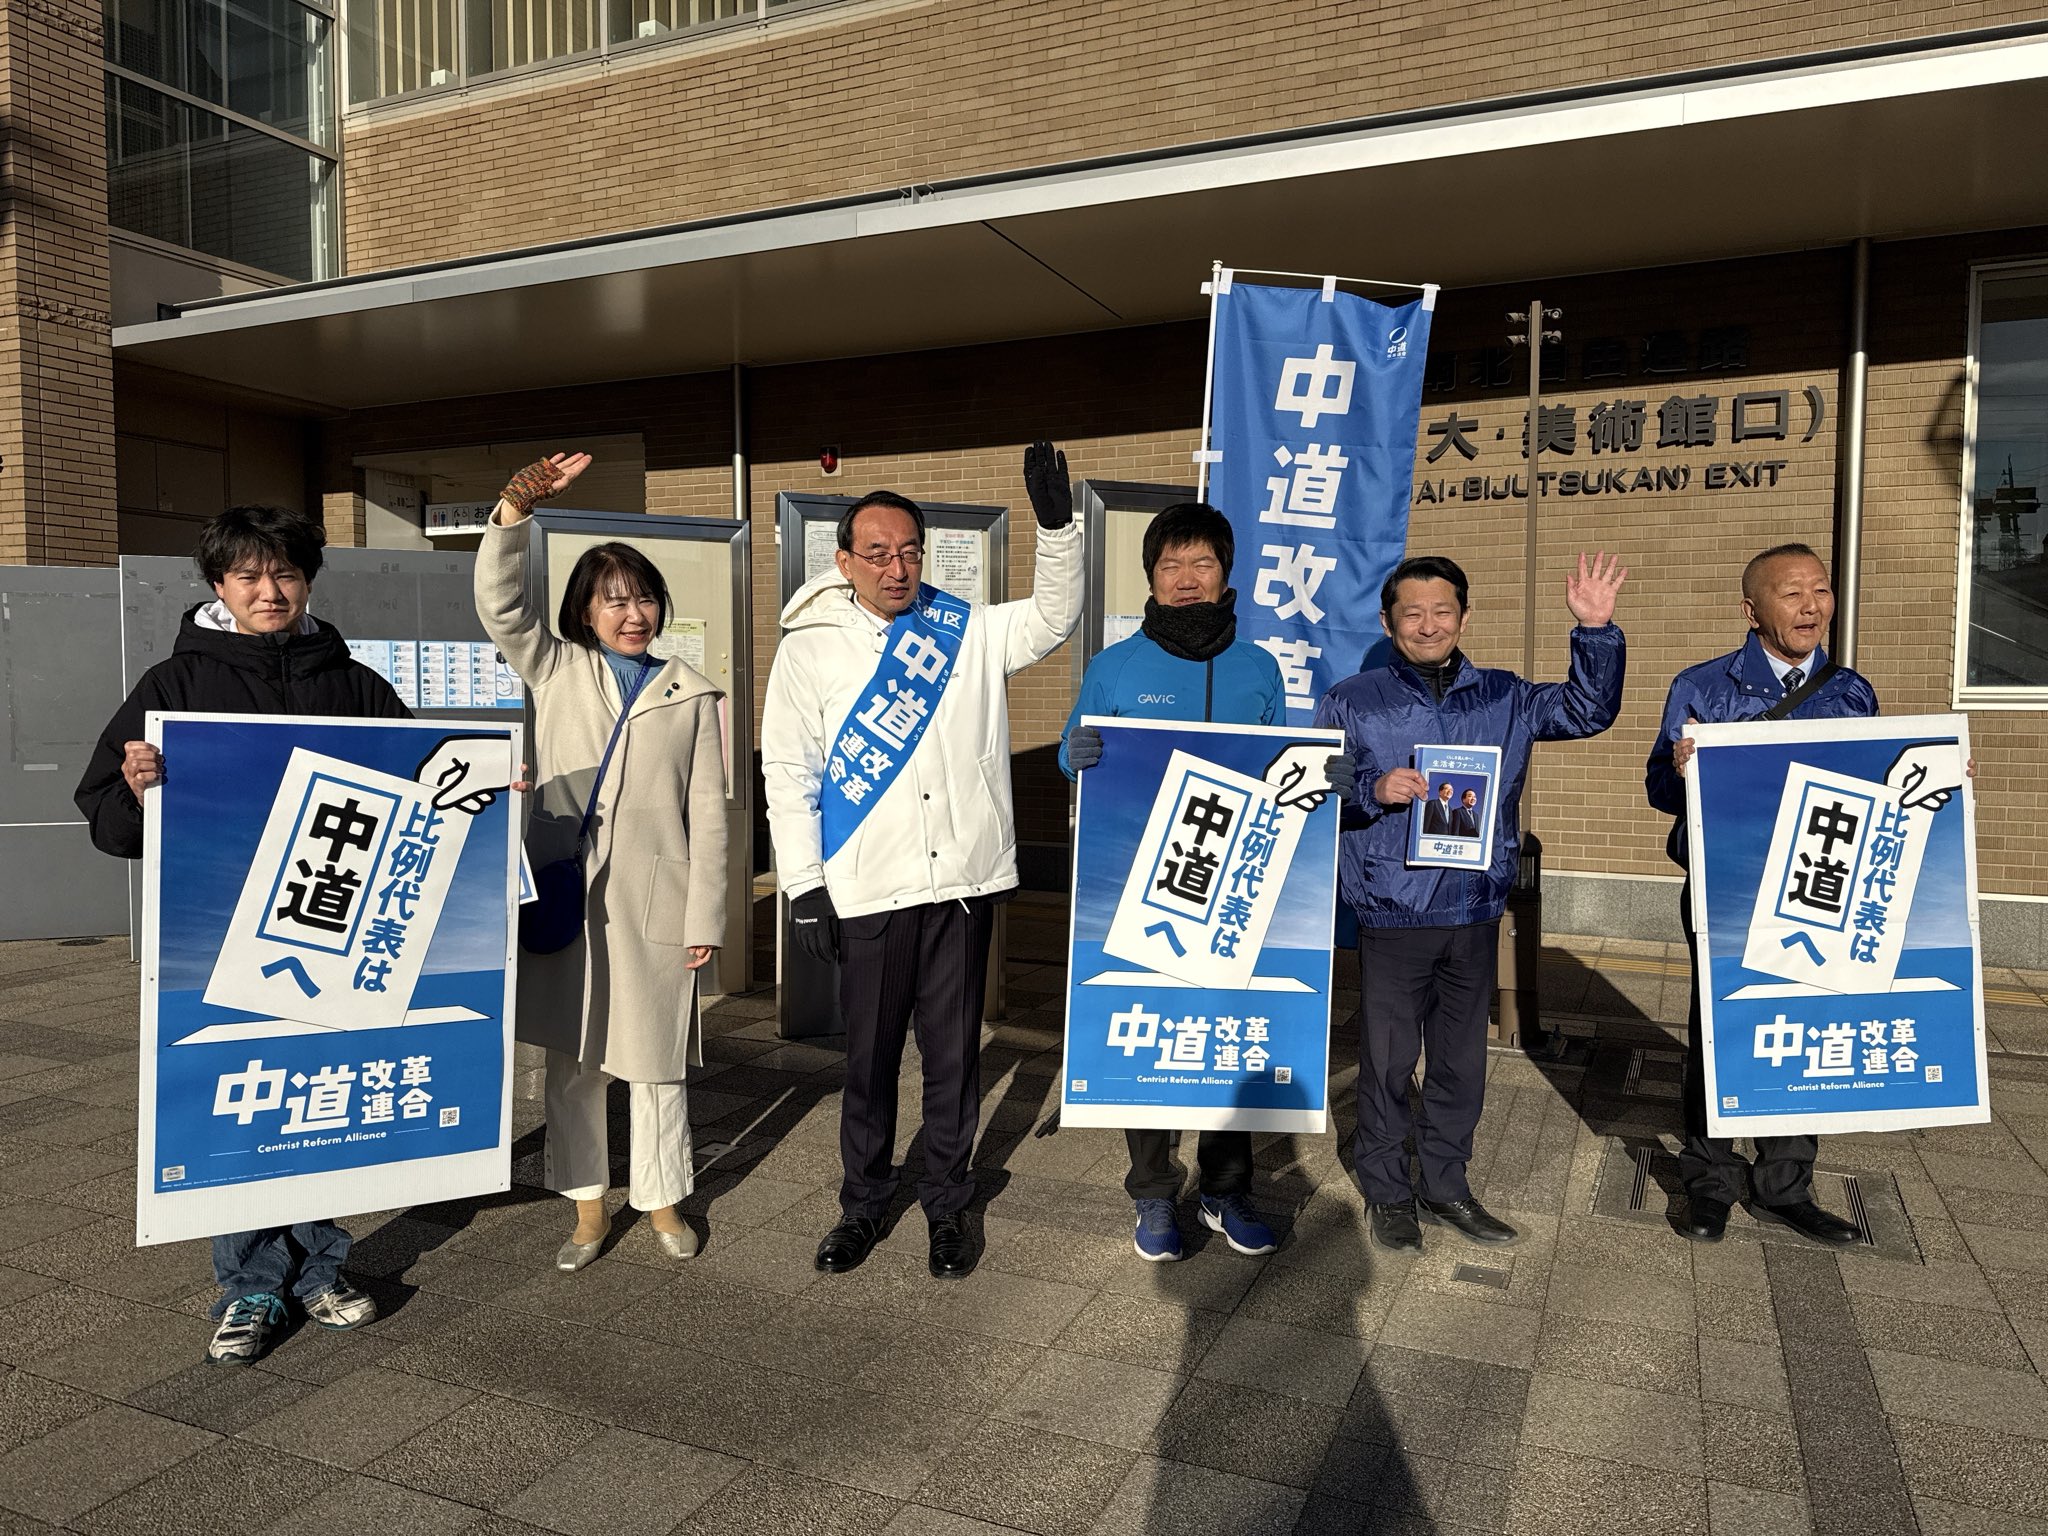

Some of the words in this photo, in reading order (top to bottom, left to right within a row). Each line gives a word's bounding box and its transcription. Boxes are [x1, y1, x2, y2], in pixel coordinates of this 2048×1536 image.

[1706, 460, 1789, 489] EXIT
[475, 505, 495, 519] お手
[1253, 343, 1357, 711] 中道改革
[855, 629, 948, 751] 中道
[829, 727, 869, 784] 連合
[839, 746, 894, 806] 改革
[1432, 759, 1486, 771] 生活者ファースト
[277, 798, 380, 934] 中道
[1156, 792, 1234, 906] 中道
[1433, 841, 1452, 855] 中道
[1787, 801, 1858, 914] 中道
[353, 801, 445, 993] 比例代表は
[1211, 798, 1286, 960] 比例代表は
[1849, 801, 1911, 964] 比例代表は
[1144, 920, 1187, 958] へ
[1780, 931, 1826, 967] へ
[261, 956, 321, 999] へ
[1106, 1003, 1211, 1071] 中道
[1215, 1016, 1269, 1044] 改革
[1213, 1044, 1270, 1071] 連合
[1753, 1014, 1857, 1078] 中道
[1860, 1018, 1917, 1046] 改革
[1861, 1046, 1919, 1075] 連合
[212, 1059, 357, 1134] 中道
[362, 1055, 432, 1091] 改革
[1137, 1075, 1168, 1085] Centrist
[1170, 1076, 1199, 1085] Reform
[1201, 1077, 1233, 1085] Alliance
[1787, 1083, 1819, 1092] Centrist
[1820, 1082, 1850, 1091] Reform
[1852, 1081, 1885, 1090] Alliance
[361, 1087, 433, 1125] 連合
[257, 1141, 300, 1154] Centrist
[303, 1136, 342, 1148] Reform
[345, 1130, 387, 1143] Alliance
